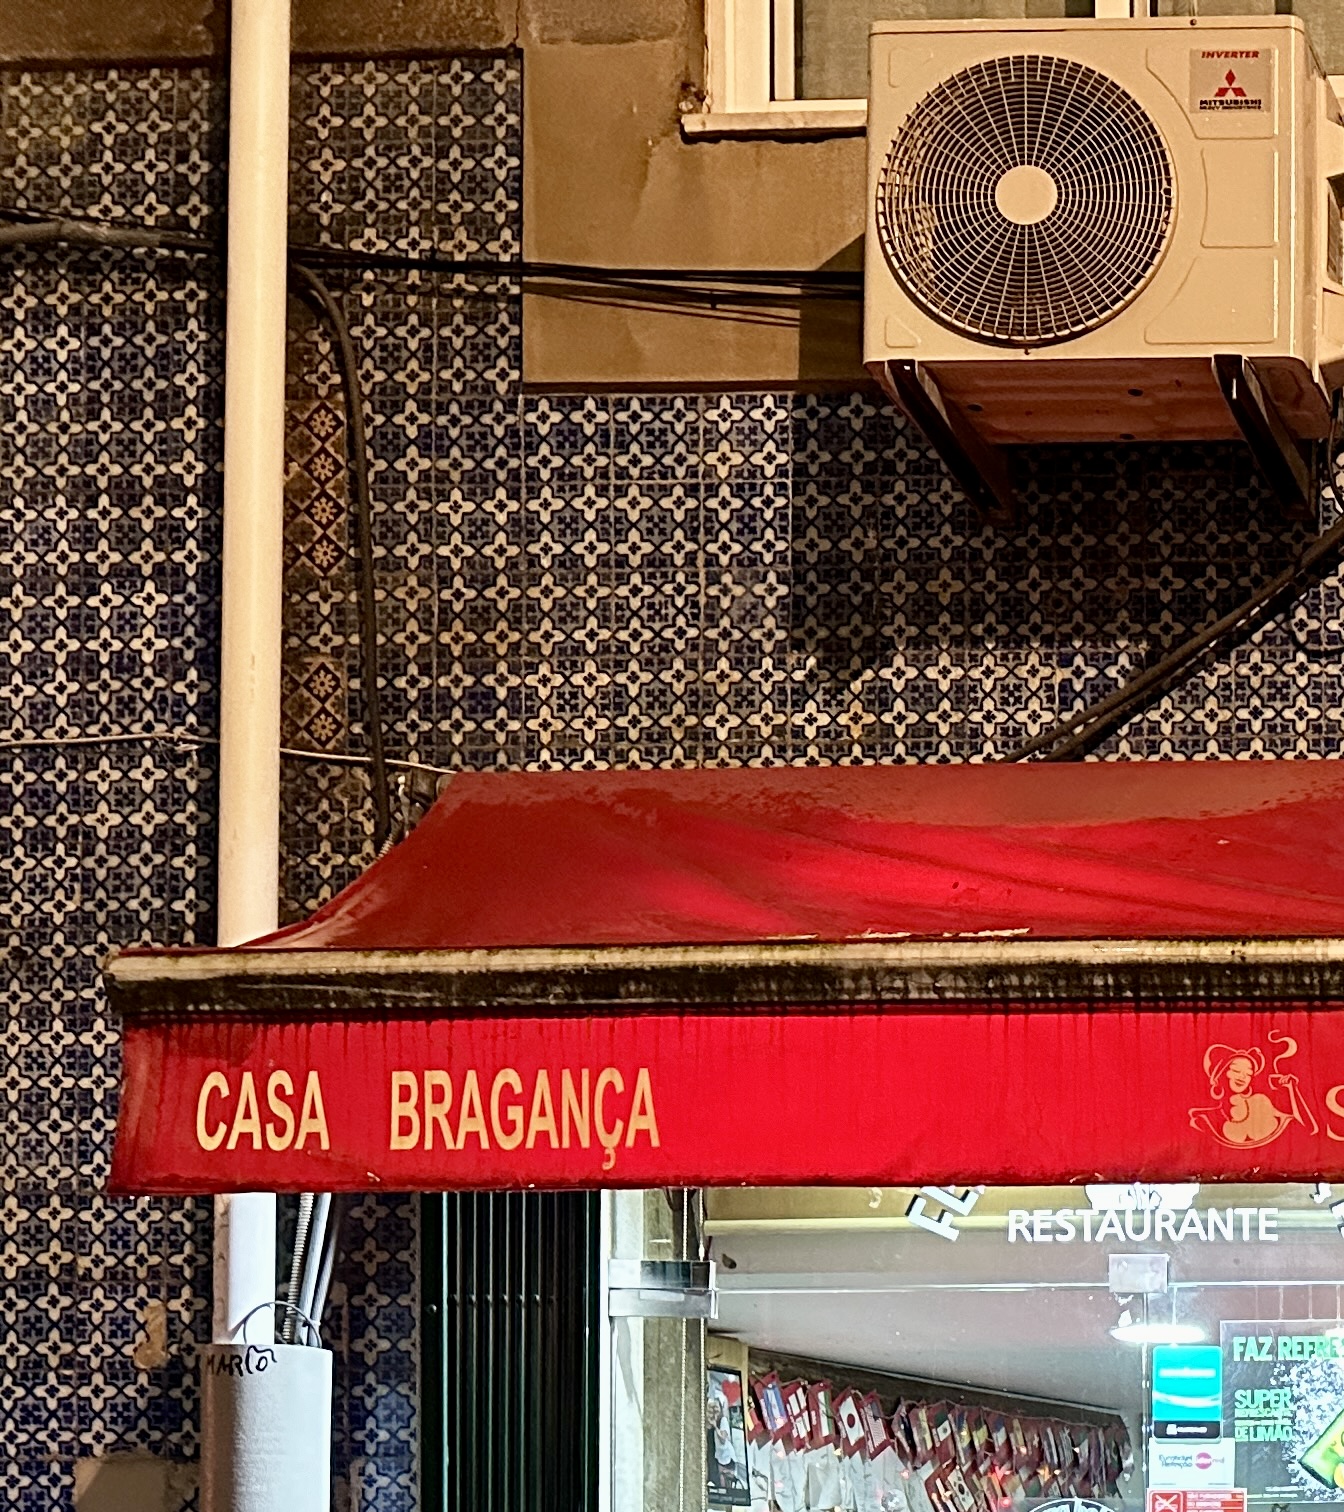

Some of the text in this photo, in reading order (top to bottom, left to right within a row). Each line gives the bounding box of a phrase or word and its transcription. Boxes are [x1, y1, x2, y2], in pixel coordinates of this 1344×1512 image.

[1201, 50, 1260, 59] INVERTER
[196, 1067, 662, 1171] CASA BRAGANÇA
[1007, 1207, 1279, 1242] RESTAURANTE
[1233, 1336, 1273, 1361] FAZ
[1235, 1389, 1292, 1409] SUPER
